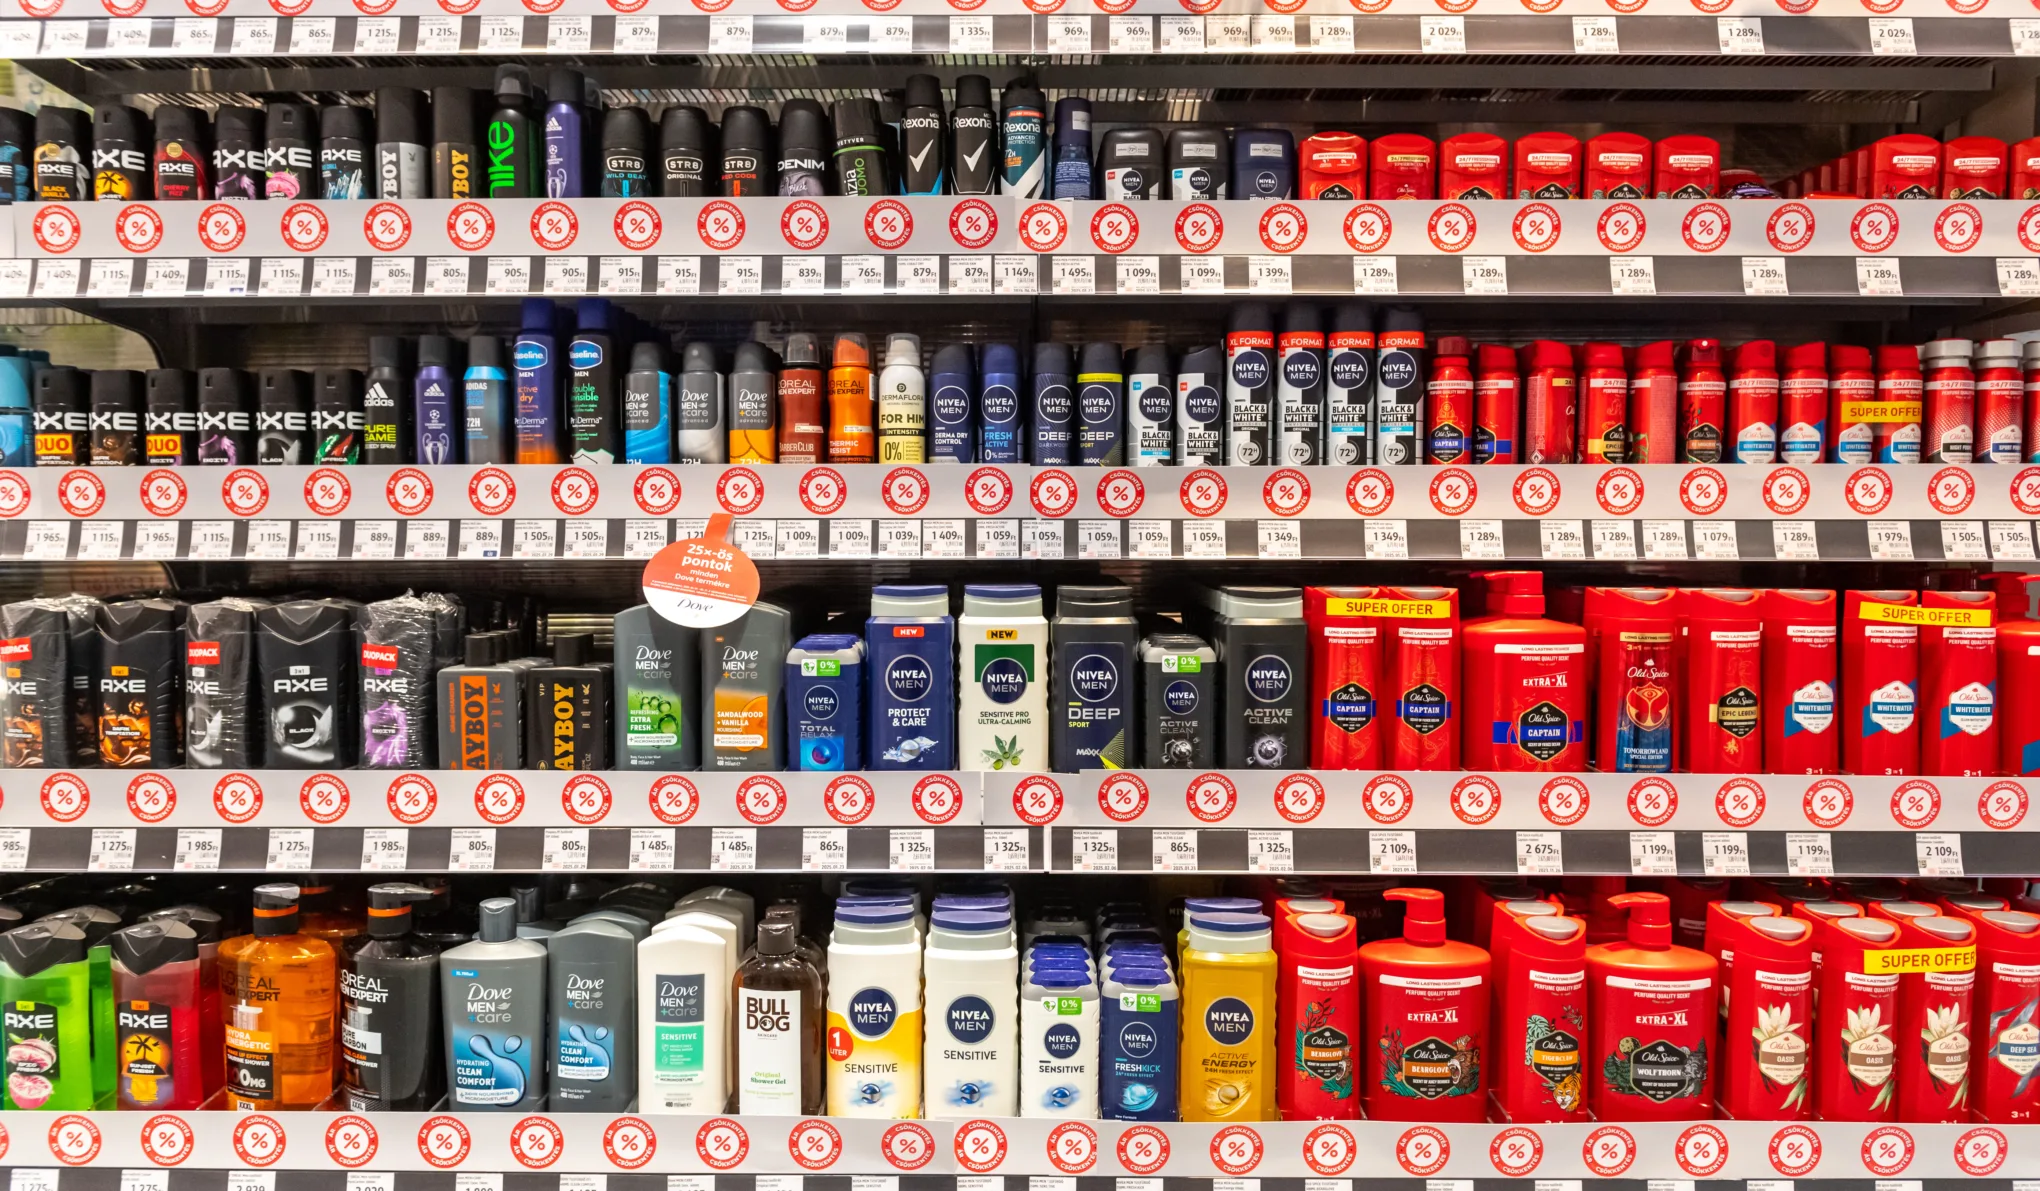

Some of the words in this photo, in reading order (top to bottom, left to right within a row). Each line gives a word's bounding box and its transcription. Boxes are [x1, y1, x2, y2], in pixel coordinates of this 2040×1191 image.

[899, 119, 938, 128] Rexona
[1004, 123, 1040, 132] Rexona
[36, 164, 73, 173] AXE
[611, 161, 641, 169] STR8
[670, 160, 699, 168] STR8
[725, 160, 751, 168] STR8
[1229, 337, 1240, 347] XL
[1242, 338, 1270, 347] FORMAT
[739, 389, 767, 401] Dove
[1850, 408, 1887, 416] SUPER
[1891, 406, 1923, 416] OFFER
[881, 414, 902, 423] FOR
[907, 414, 926, 424] HIM
[1233, 413, 1264, 422] WHITE
[985, 432, 1012, 440] FRESH
[1082, 432, 1114, 440] DEEP
[885, 442, 901, 460] 0%
[1243, 448, 1259, 456] 72H
[687, 544, 734, 560] 25x-ös
[682, 555, 732, 572] pontok
[690, 570, 718, 579] minden
[674, 573, 695, 583] Dove
[696, 578, 730, 588] termékre
[677, 600, 712, 612] Dove
[1346, 602, 1388, 612] SUPER
[1392, 604, 1432, 614] OFFER
[1883, 608, 1923, 620] SUPER
[1929, 612, 1971, 622] OFFER
[636, 646, 671, 660] Dove
[636, 661, 658, 669] MEN
[892, 670, 926, 678] NIVEA
[1253, 670, 1286, 678] NIVEA
[1627, 667, 1646, 677] Old
[1646, 667, 1669, 679] Spice
[101, 680, 145, 692] AXE
[896, 680, 923, 688] MEN
[1256, 680, 1282, 688] MEN
[888, 708, 930, 716] PROTECT
[1069, 708, 1120, 719] DEEP
[892, 718, 900, 726] &
[902, 718, 926, 726] CARE
[1882, 955, 1930, 967] SUPER
[1935, 952, 1977, 966] OFFER
[468, 987, 512, 1000] Dove
[661, 986, 698, 996] Dove
[349, 990, 388, 1003] EXPERT
[468, 1002, 495, 1012] MEN
[747, 998, 790, 1017] BULL
[855, 1004, 892, 1012] NIVEA
[5, 1014, 53, 1028] AXE
[120, 1014, 167, 1028] AXE
[468, 1012, 511, 1023] +care
[858, 1014, 888, 1023] MEN
[1212, 1013, 1249, 1021] NIVEA
[1408, 1011, 1458, 1022] EXTRA-XL
[1636, 1014, 1687, 1025] EXTRA-XL
[747, 1014, 789, 1031] DOG
[1214, 1023, 1245, 1032] MEN
[833, 1032, 840, 1046] 1
[845, 1064, 897, 1073] SENSITIVE
[1116, 1064, 1160, 1072] FRESHKICK
